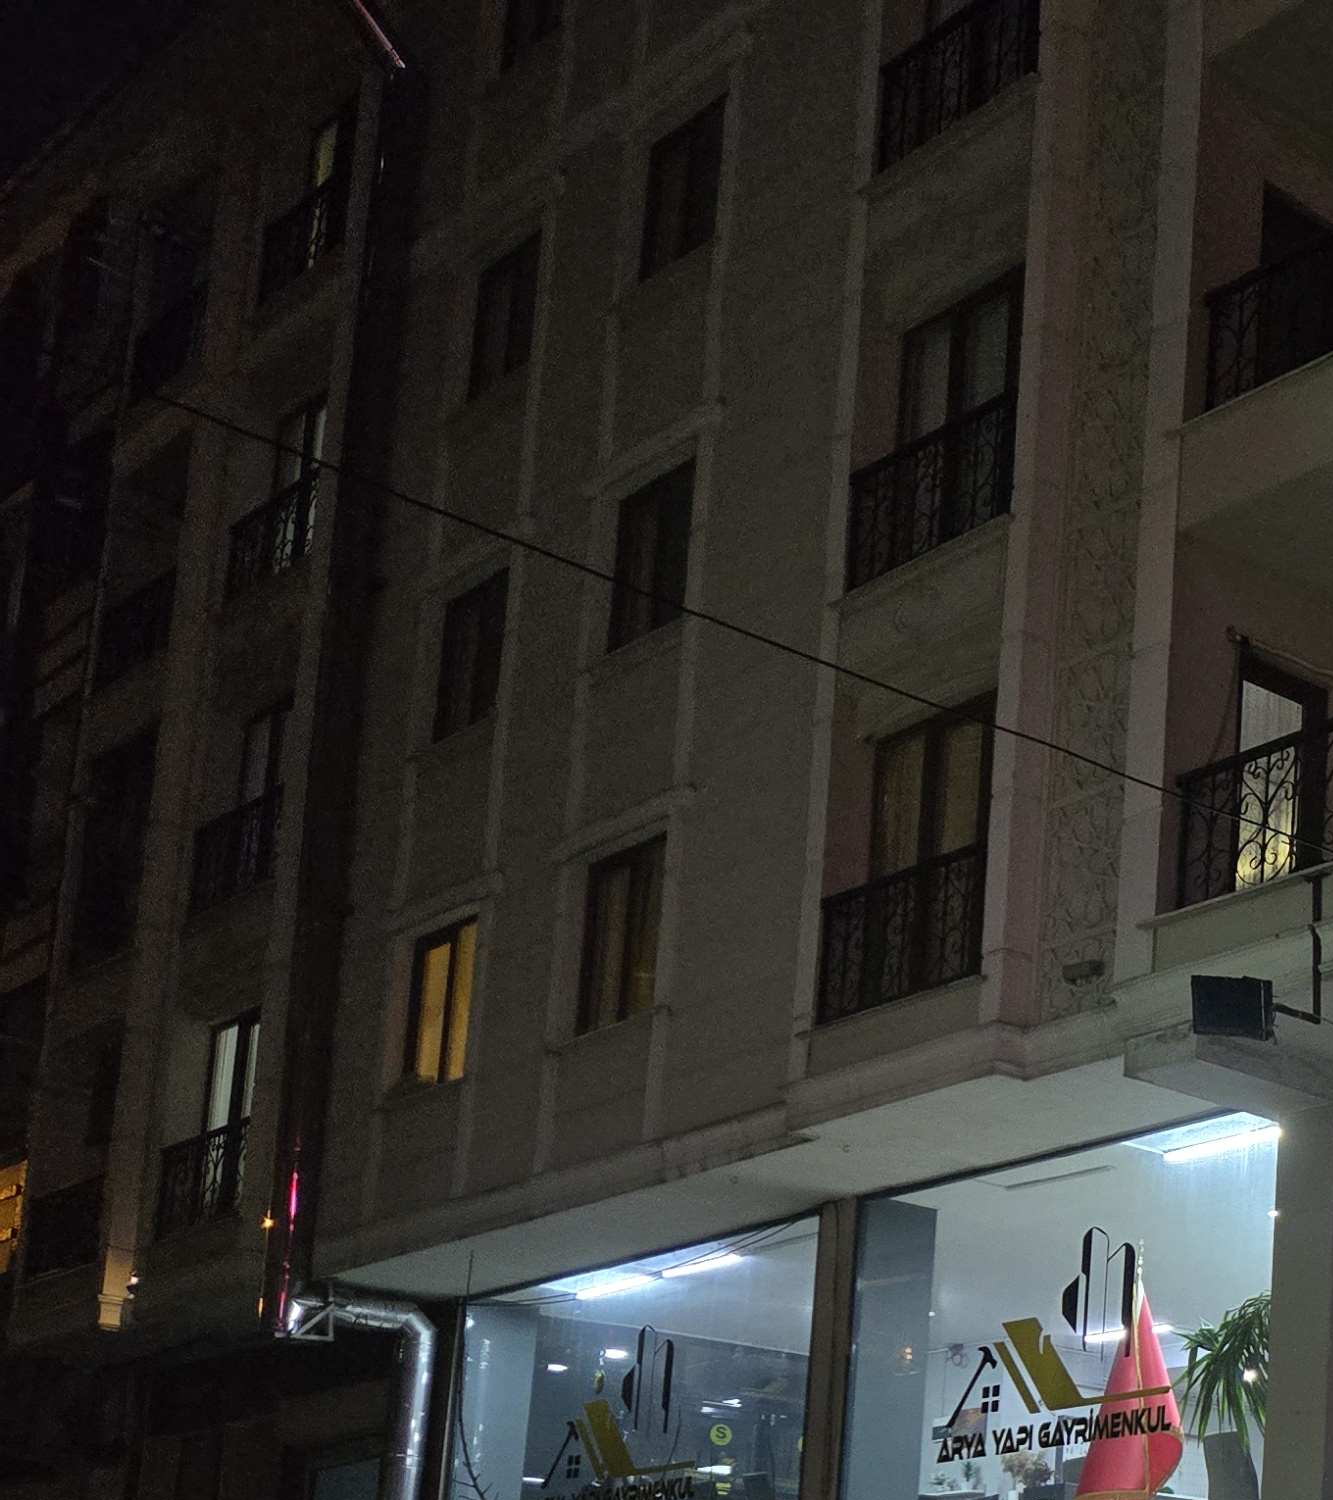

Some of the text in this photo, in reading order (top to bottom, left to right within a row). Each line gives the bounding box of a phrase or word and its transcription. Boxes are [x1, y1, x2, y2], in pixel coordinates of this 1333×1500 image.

[937, 1406, 1172, 1463] ARYA YAPI GAYRİMENKUL
